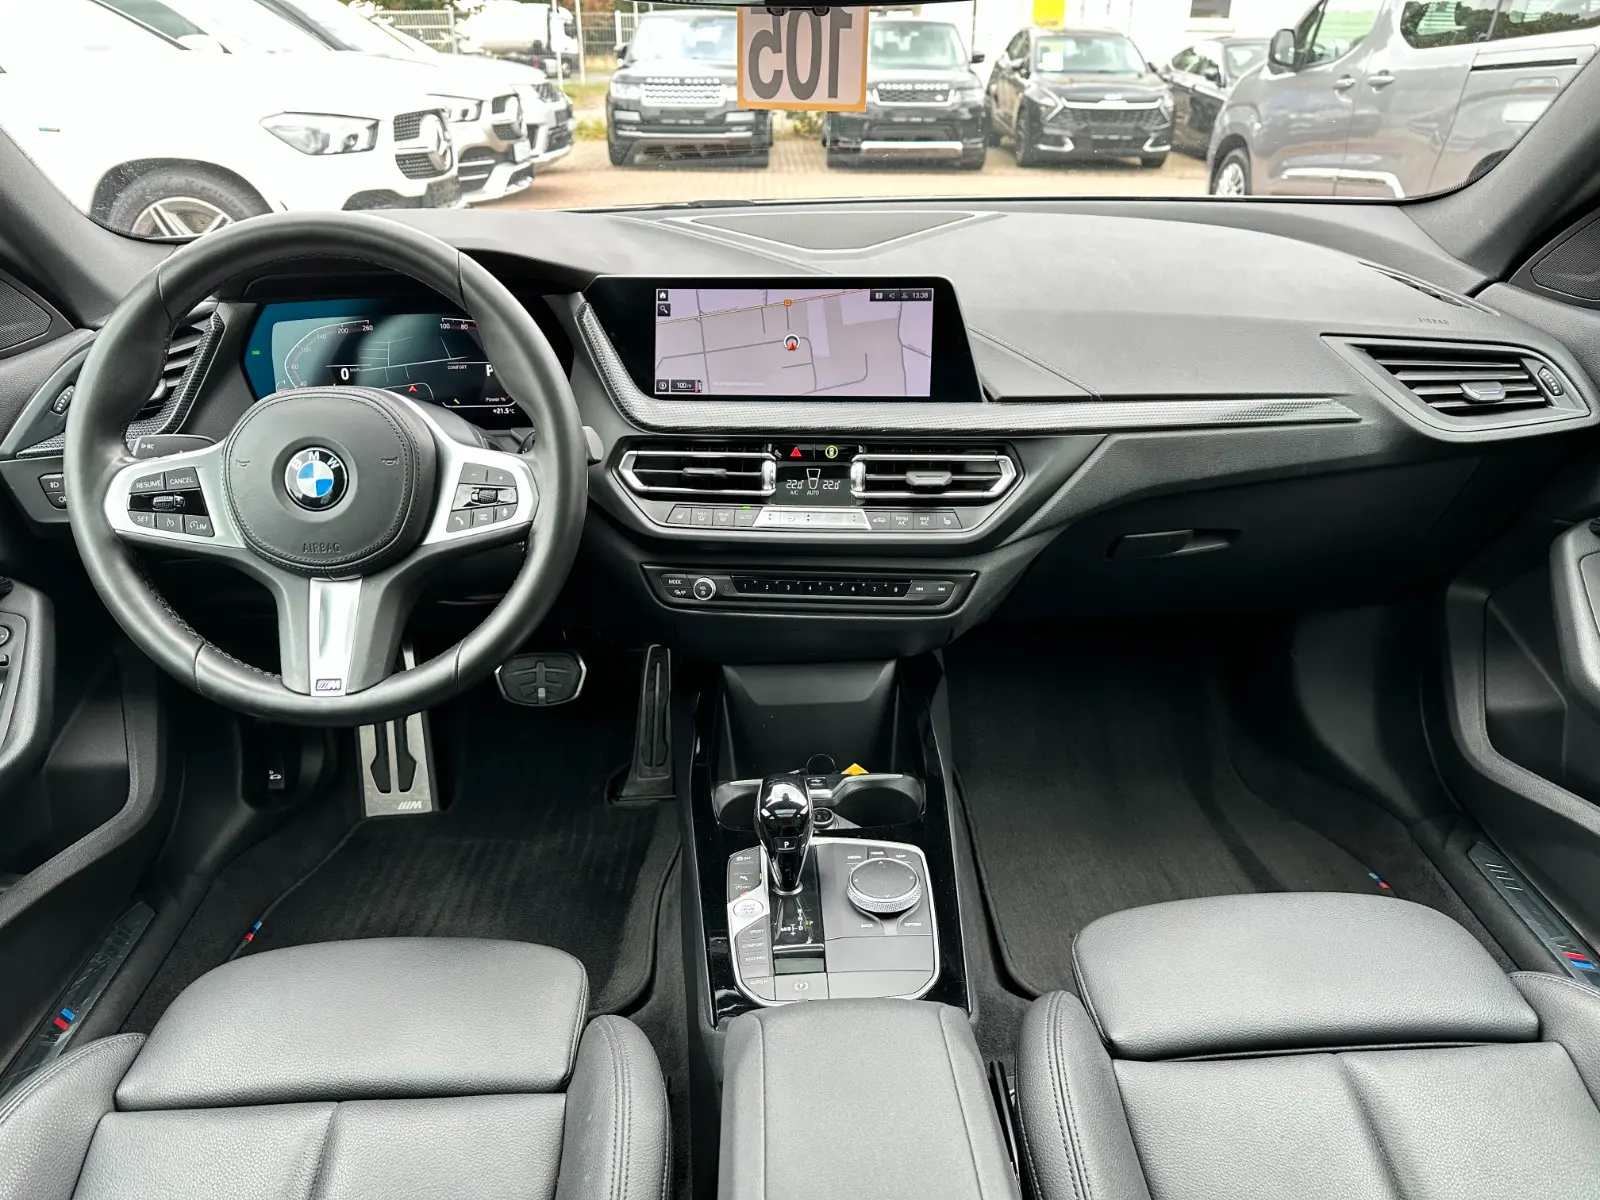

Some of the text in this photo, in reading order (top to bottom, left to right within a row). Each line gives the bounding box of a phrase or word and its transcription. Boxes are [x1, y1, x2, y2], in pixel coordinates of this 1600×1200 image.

[676, 381, 687, 389] 100
[289, 451, 341, 471] BMW
[135, 479, 162, 489] RESUME
[169, 476, 194, 485] CANCEL
[302, 543, 342, 554] AIRBAG
